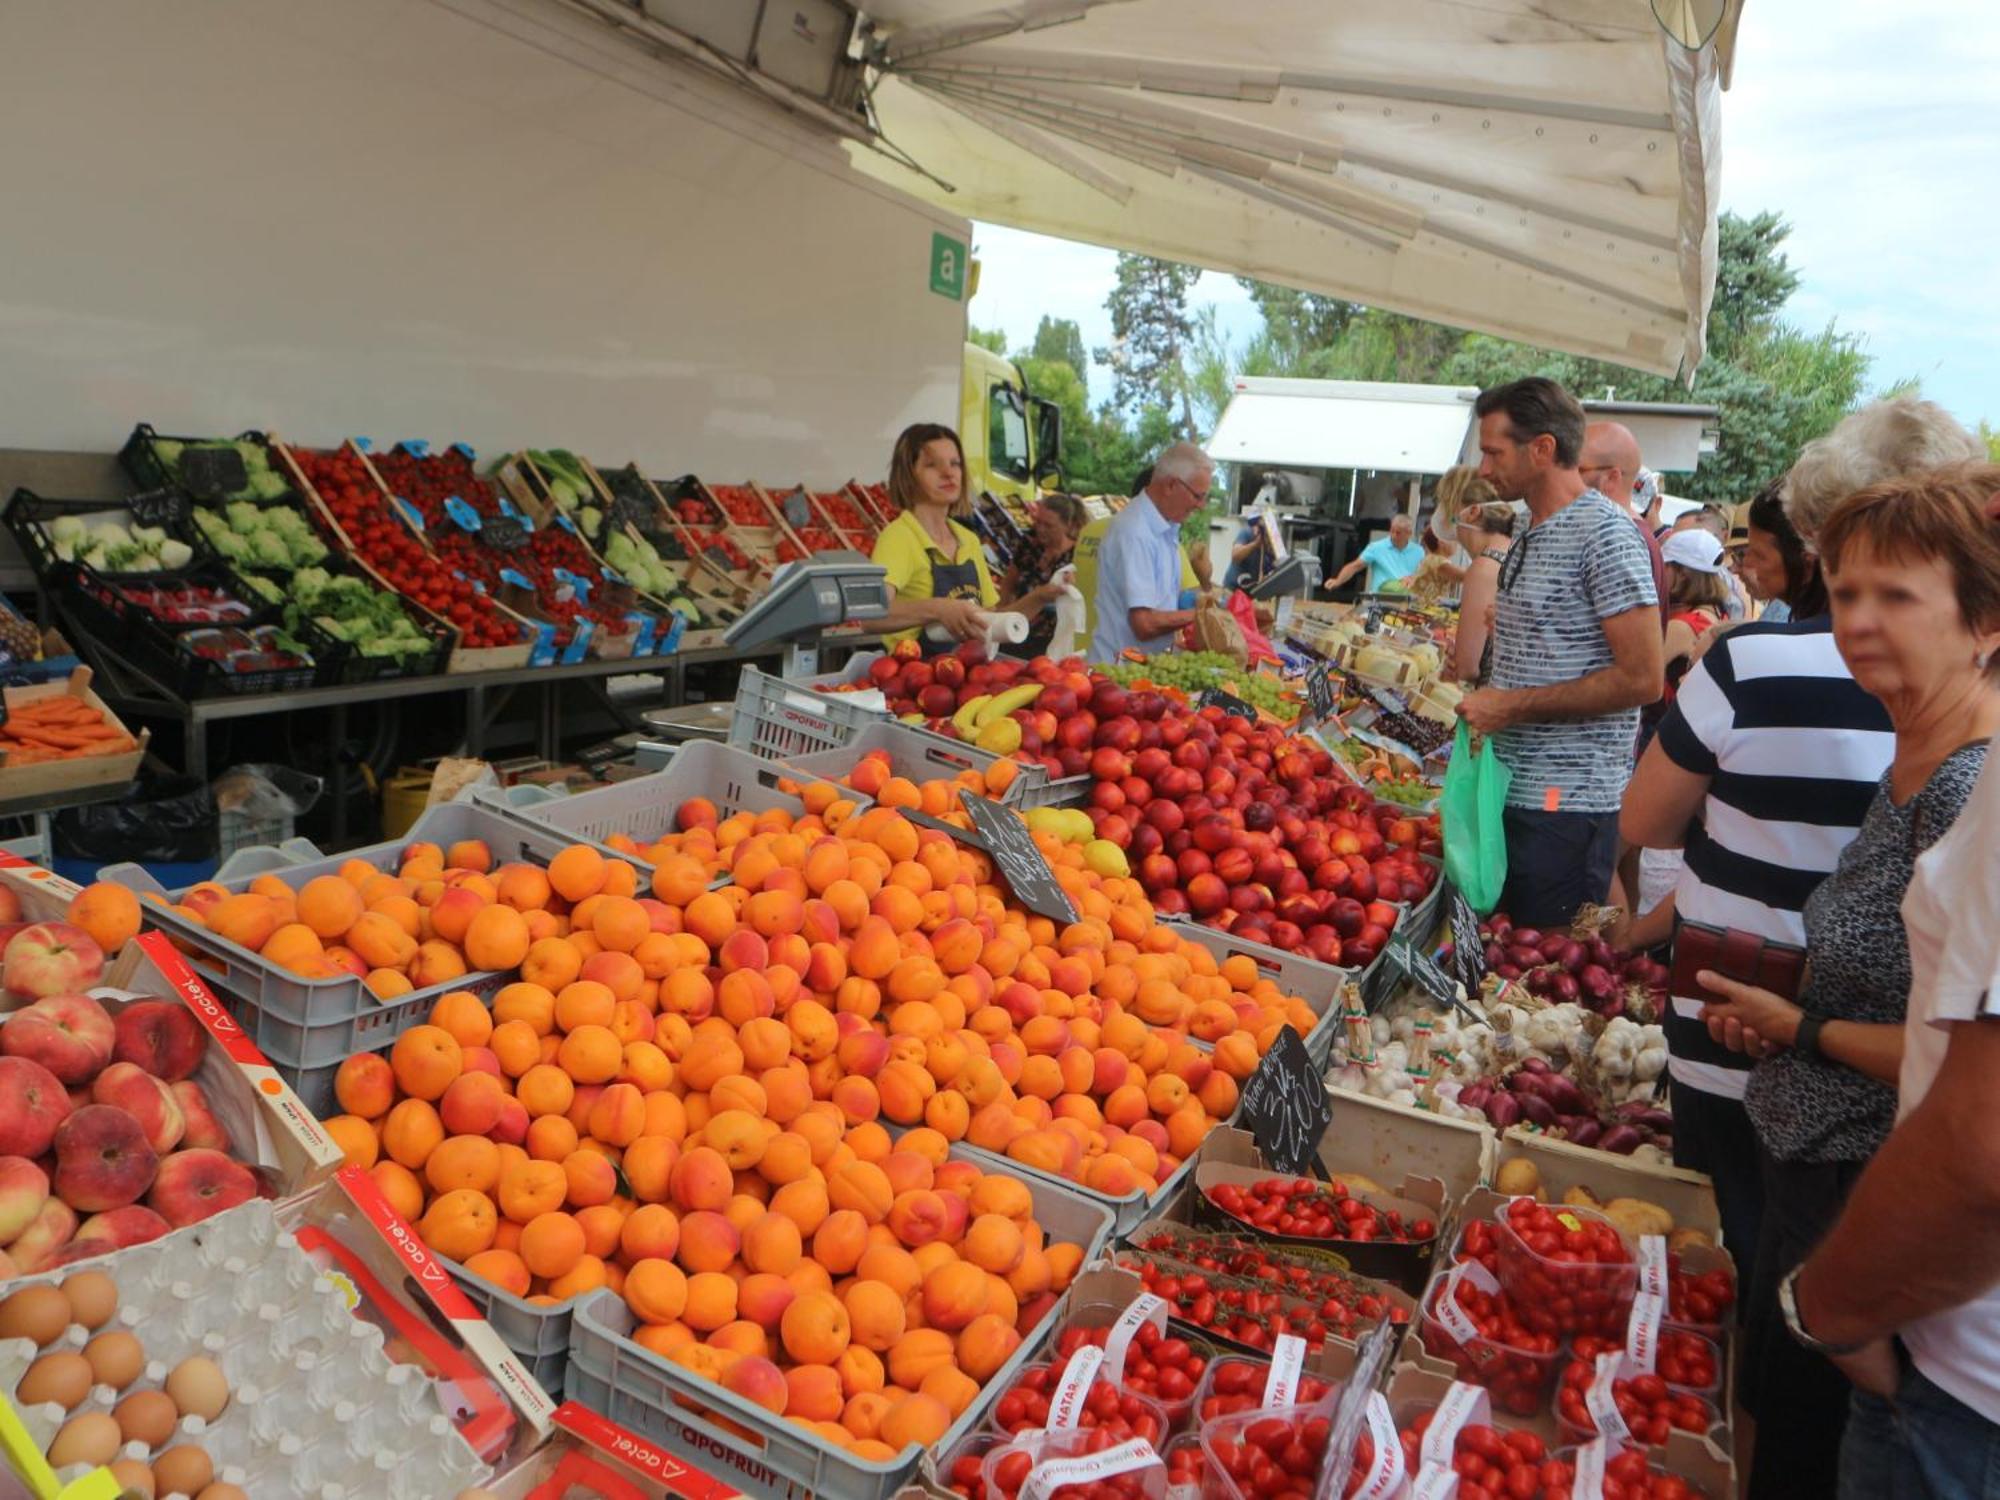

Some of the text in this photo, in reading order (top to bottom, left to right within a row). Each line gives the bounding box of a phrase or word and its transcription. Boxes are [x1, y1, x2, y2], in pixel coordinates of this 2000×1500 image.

[182, 978, 220, 1017] actel
[385, 1220, 426, 1265] actel
[611, 1435, 661, 1468] actel
